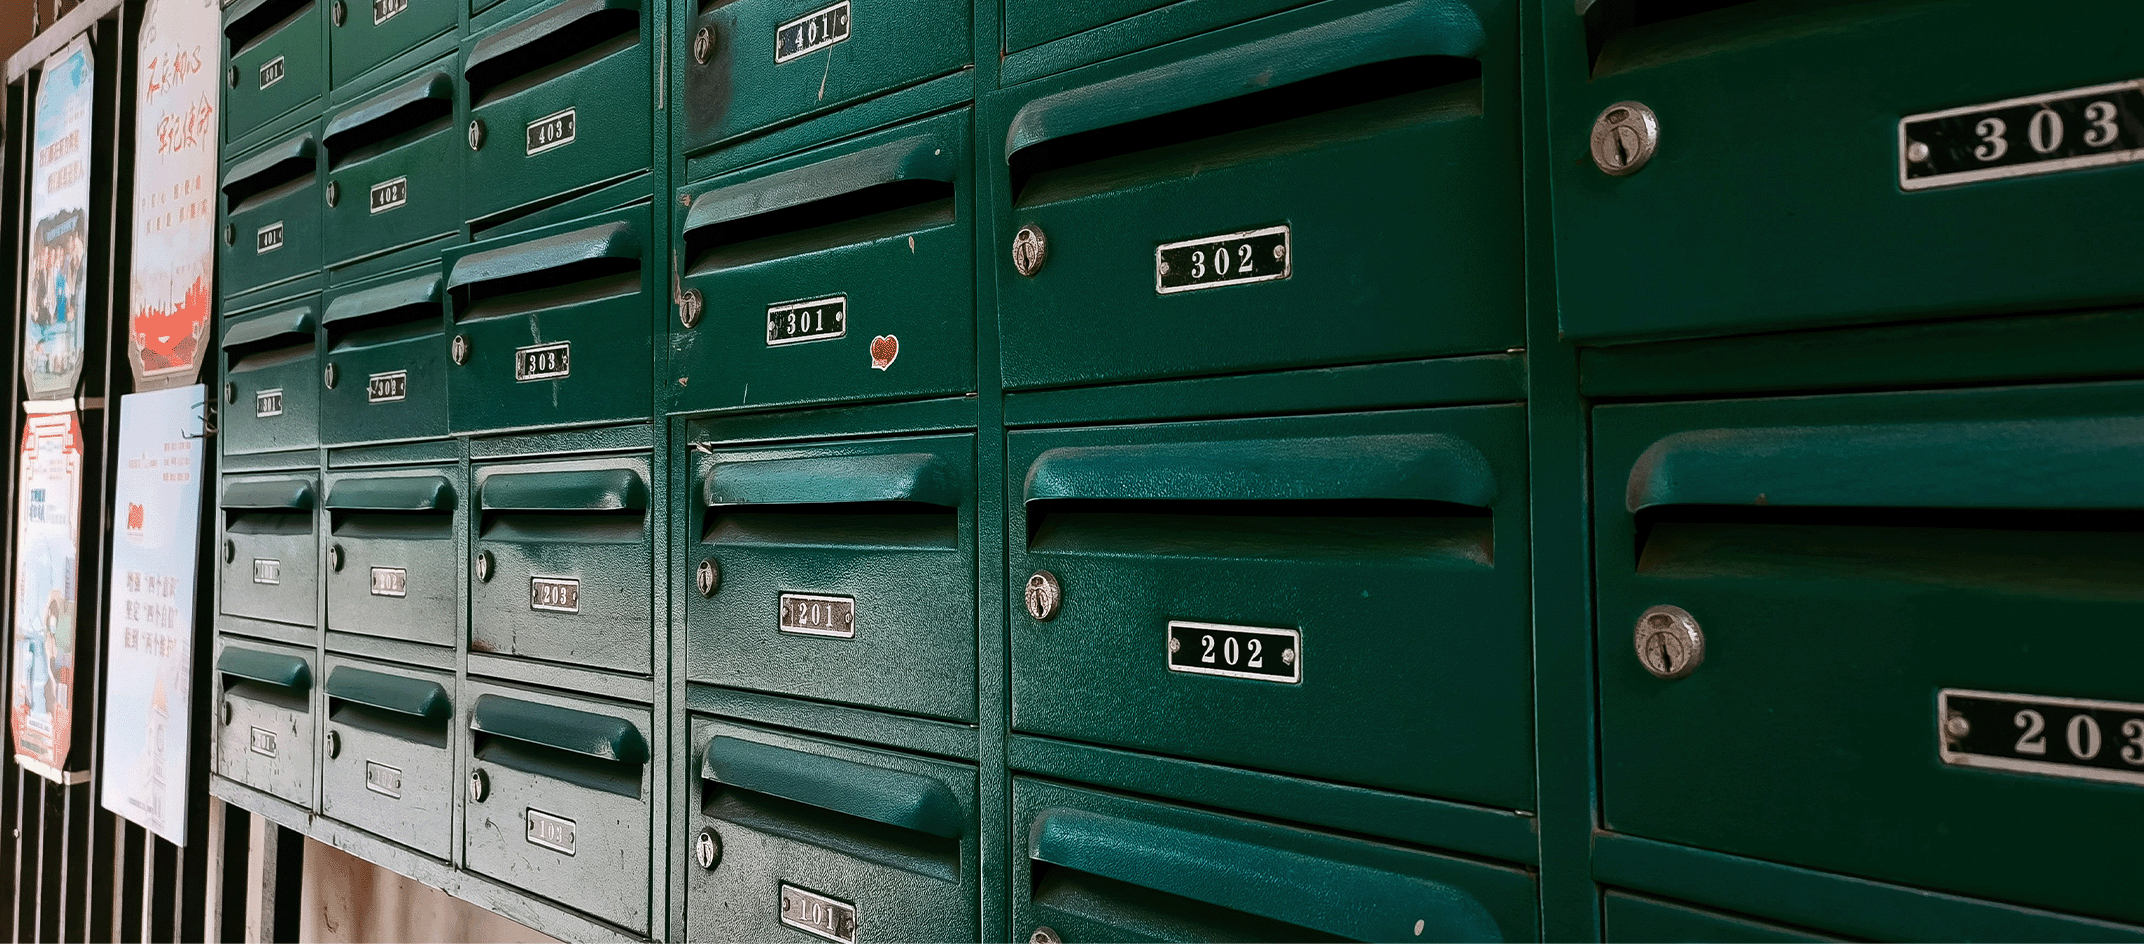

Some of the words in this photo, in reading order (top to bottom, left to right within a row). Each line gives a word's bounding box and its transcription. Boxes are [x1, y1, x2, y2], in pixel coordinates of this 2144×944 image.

[795, 13, 829, 48] 401
[539, 120, 563, 144] 403
[1974, 101, 2119, 161] 303
[379, 186, 398, 204] 402
[263, 230, 276, 246] 401
[1191, 244, 1254, 278] 302
[787, 309, 823, 335] 301
[529, 352, 556, 372] 303
[378, 380, 397, 396] 302
[263, 397, 275, 411] 301
[544, 586, 567, 605] 203
[799, 602, 834, 628] 201
[1201, 634, 1263, 669] 202
[2013, 709, 2144, 765] 203
[540, 820, 563, 843] 103
[801, 899, 834, 931] 101
